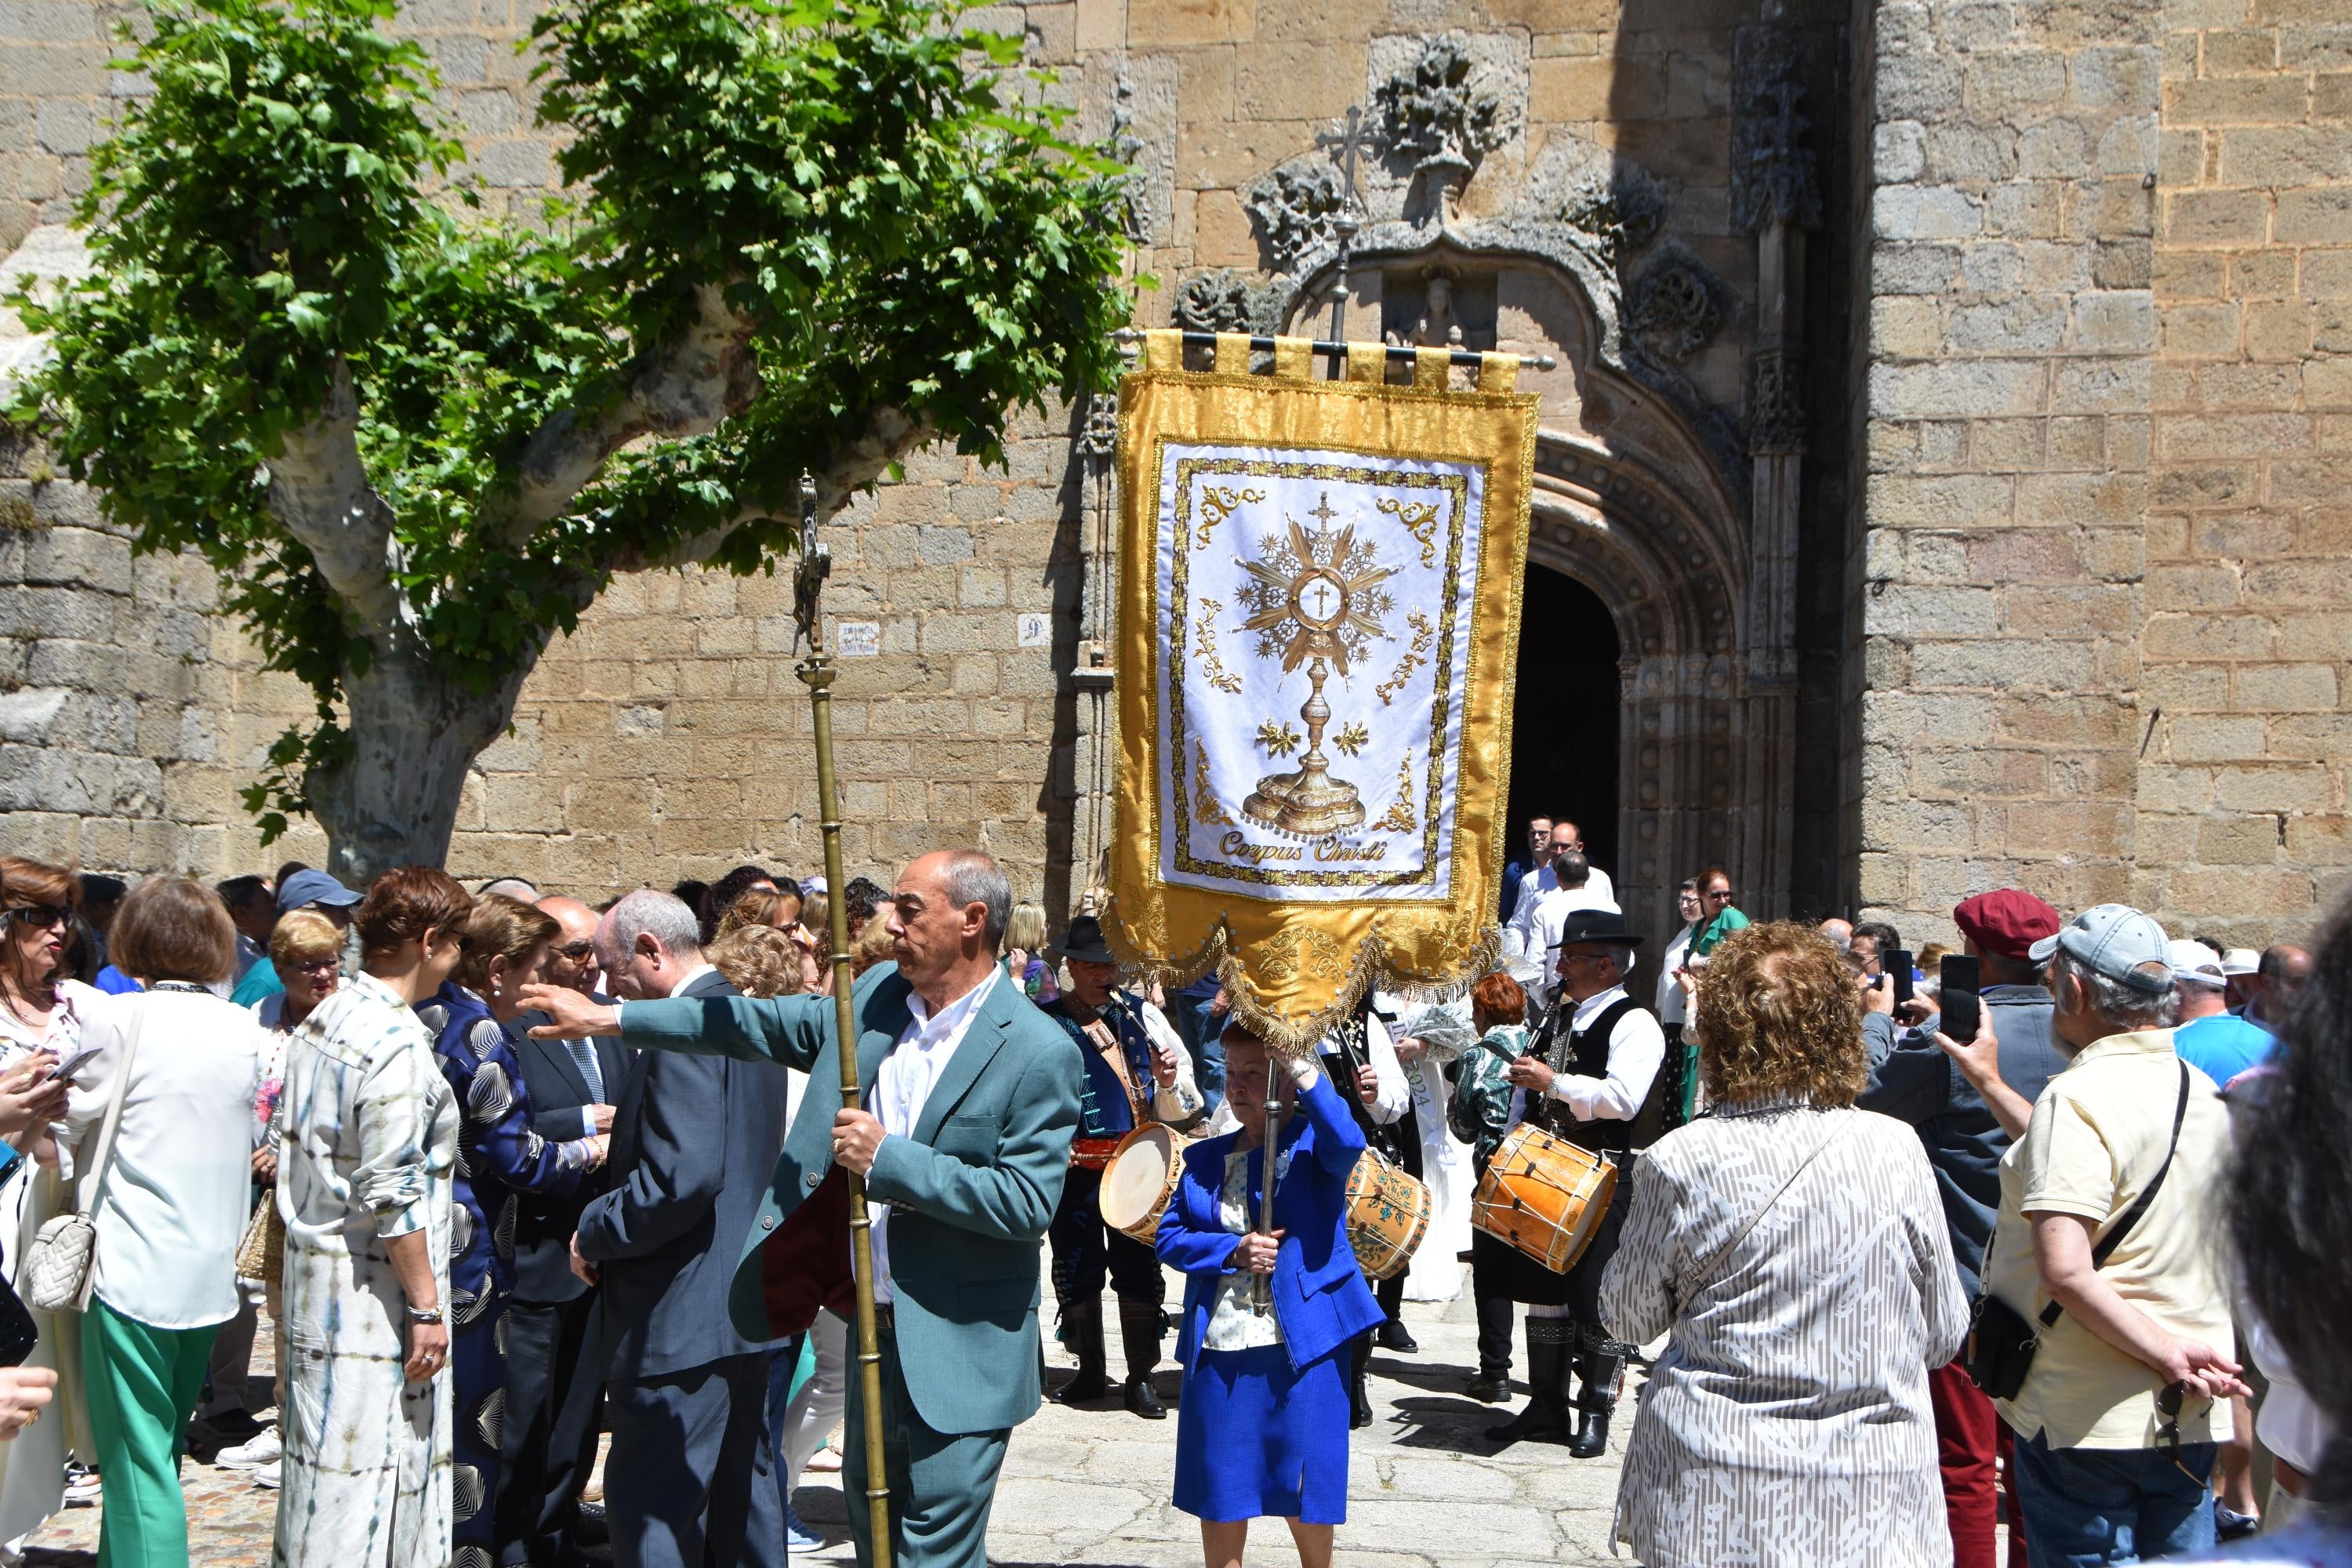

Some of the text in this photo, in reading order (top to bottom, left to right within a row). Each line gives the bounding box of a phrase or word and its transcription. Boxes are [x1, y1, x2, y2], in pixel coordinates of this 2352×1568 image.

[1219, 830, 1387, 864] Corpus Christi
[1404, 1059, 1431, 1107] 2024
